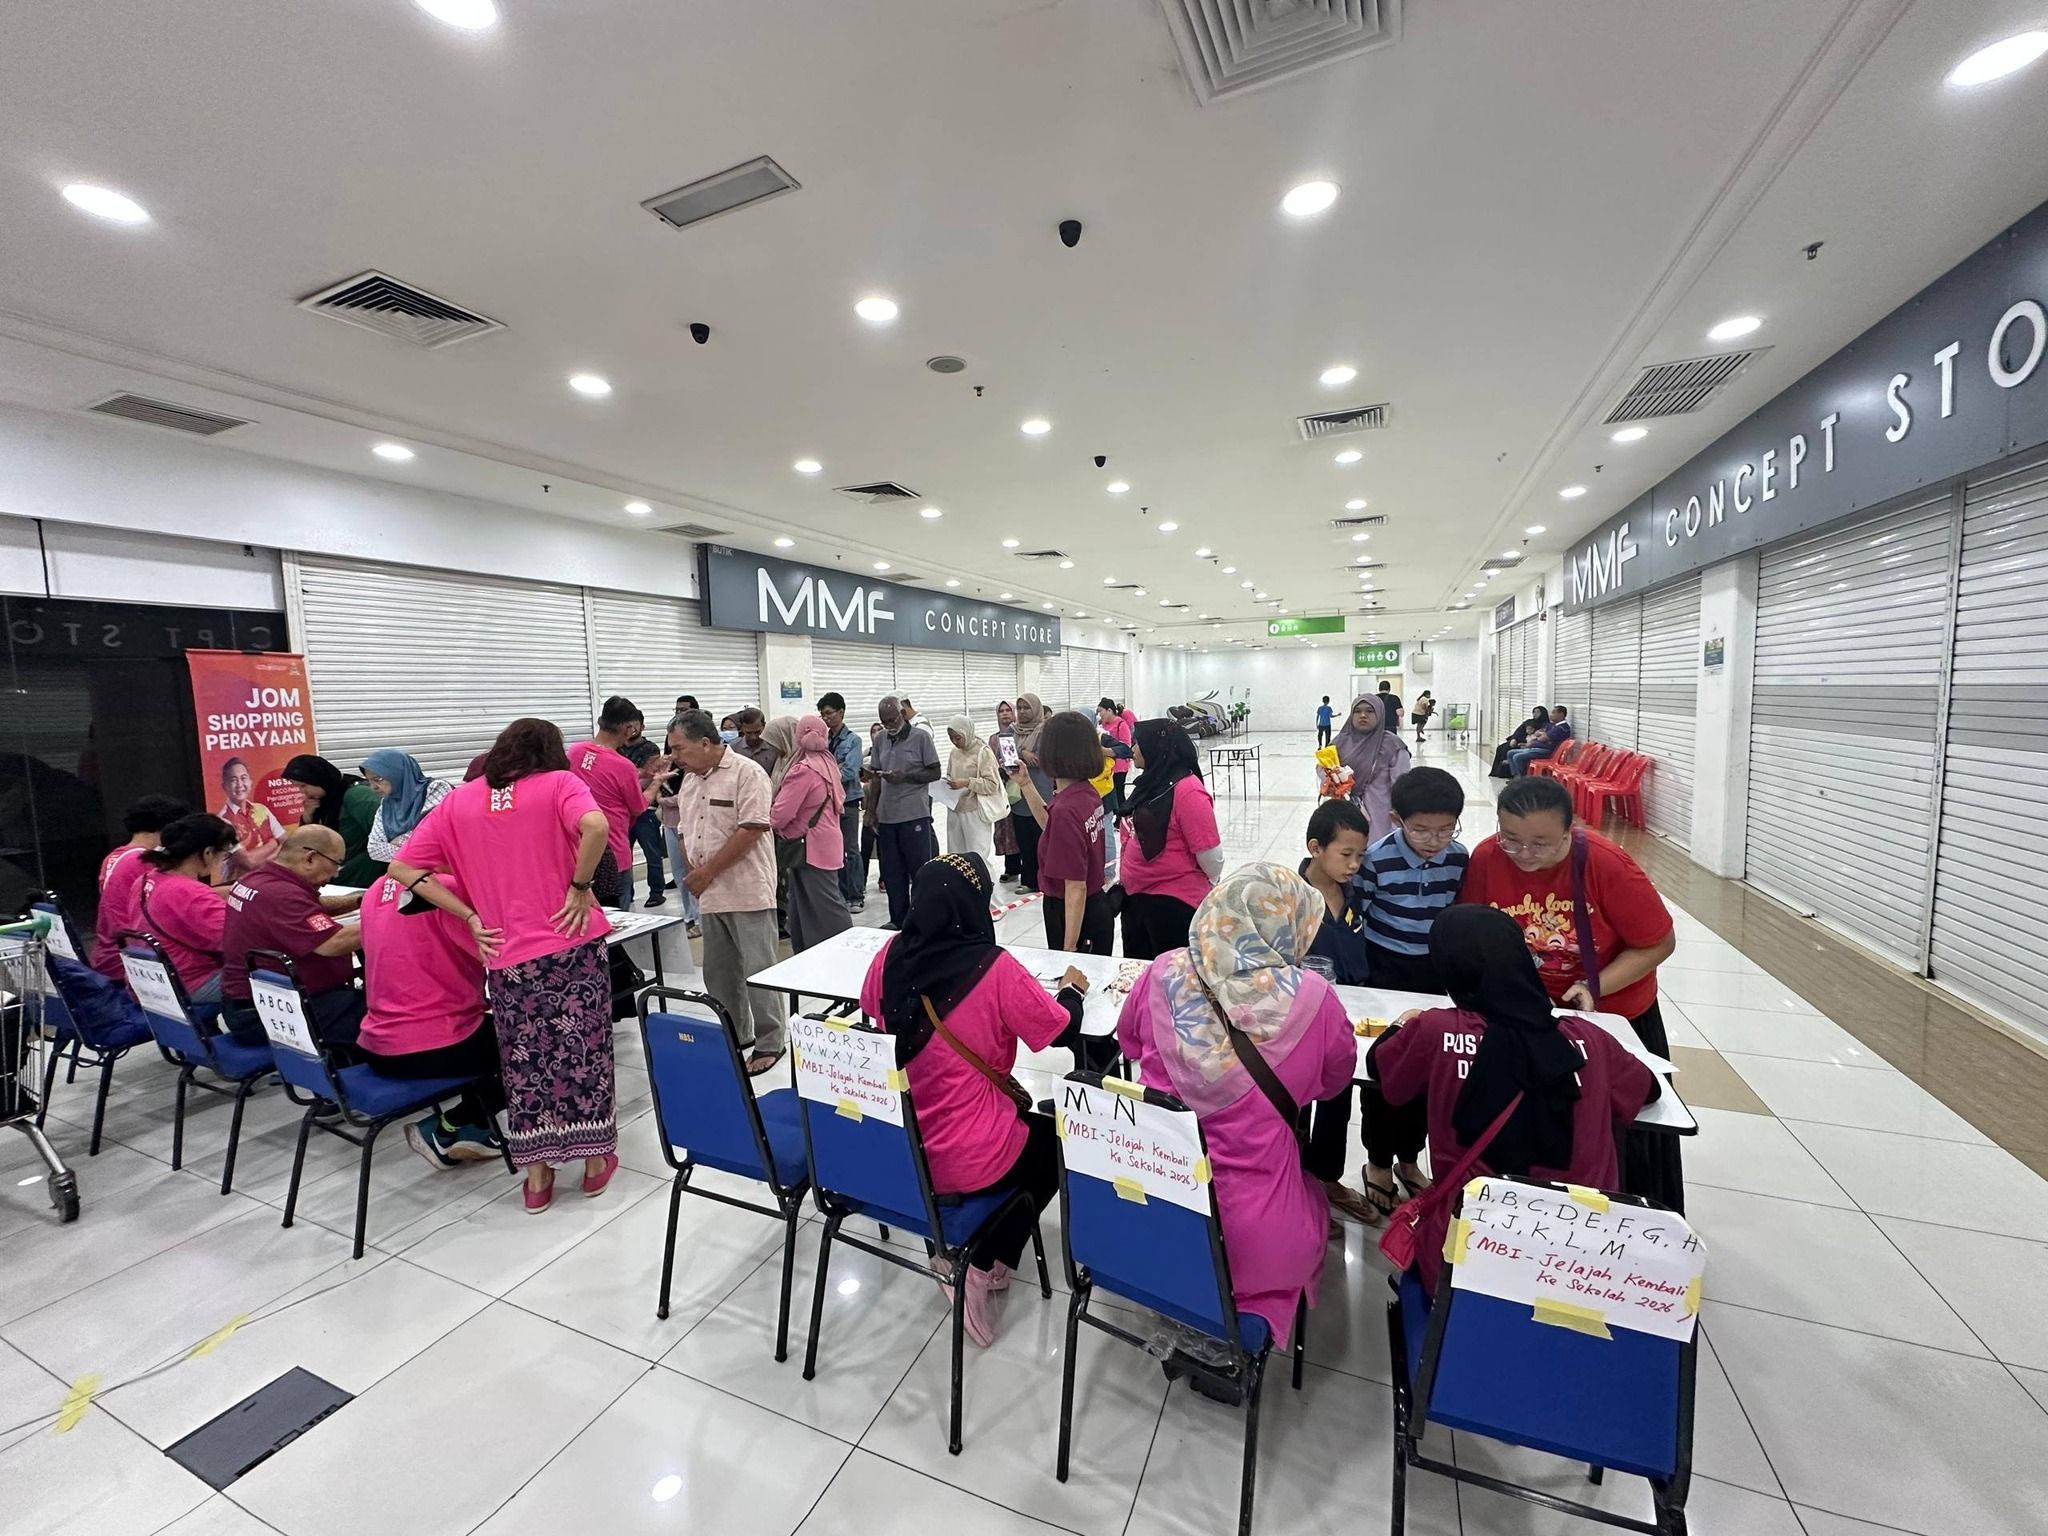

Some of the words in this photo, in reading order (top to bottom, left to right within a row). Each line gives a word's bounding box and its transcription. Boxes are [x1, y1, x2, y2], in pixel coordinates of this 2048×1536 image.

[1572, 521, 1638, 605] MMF
[1665, 411, 1841, 548] CONCEPT
[1884, 299, 2047, 443] STO
[757, 567, 895, 634] MMF
[925, 610, 1006, 639] CONCEPT
[1014, 623, 1052, 644] STORE
[245, 687, 300, 708] JOM
[207, 711, 304, 731] SHOPPING
[205, 728, 307, 751] PERAYAAN
[268, 779, 282, 787] NG
[490, 801, 513, 812] RA
[491, 792, 513, 802] RA
[830, 1082, 840, 1094] Ke
[842, 1087, 868, 1101] Sekolah
[857, 1074, 887, 1090] Kembali
[1110, 1149, 1122, 1164] Ke
[1127, 1155, 1166, 1177] Sekolah
[1152, 1141, 1189, 1167] Kembali
[1536, 1270, 1557, 1286] Ke
[1566, 1279, 1626, 1303] Sekolah
[1624, 1273, 1688, 1297] Kembali
